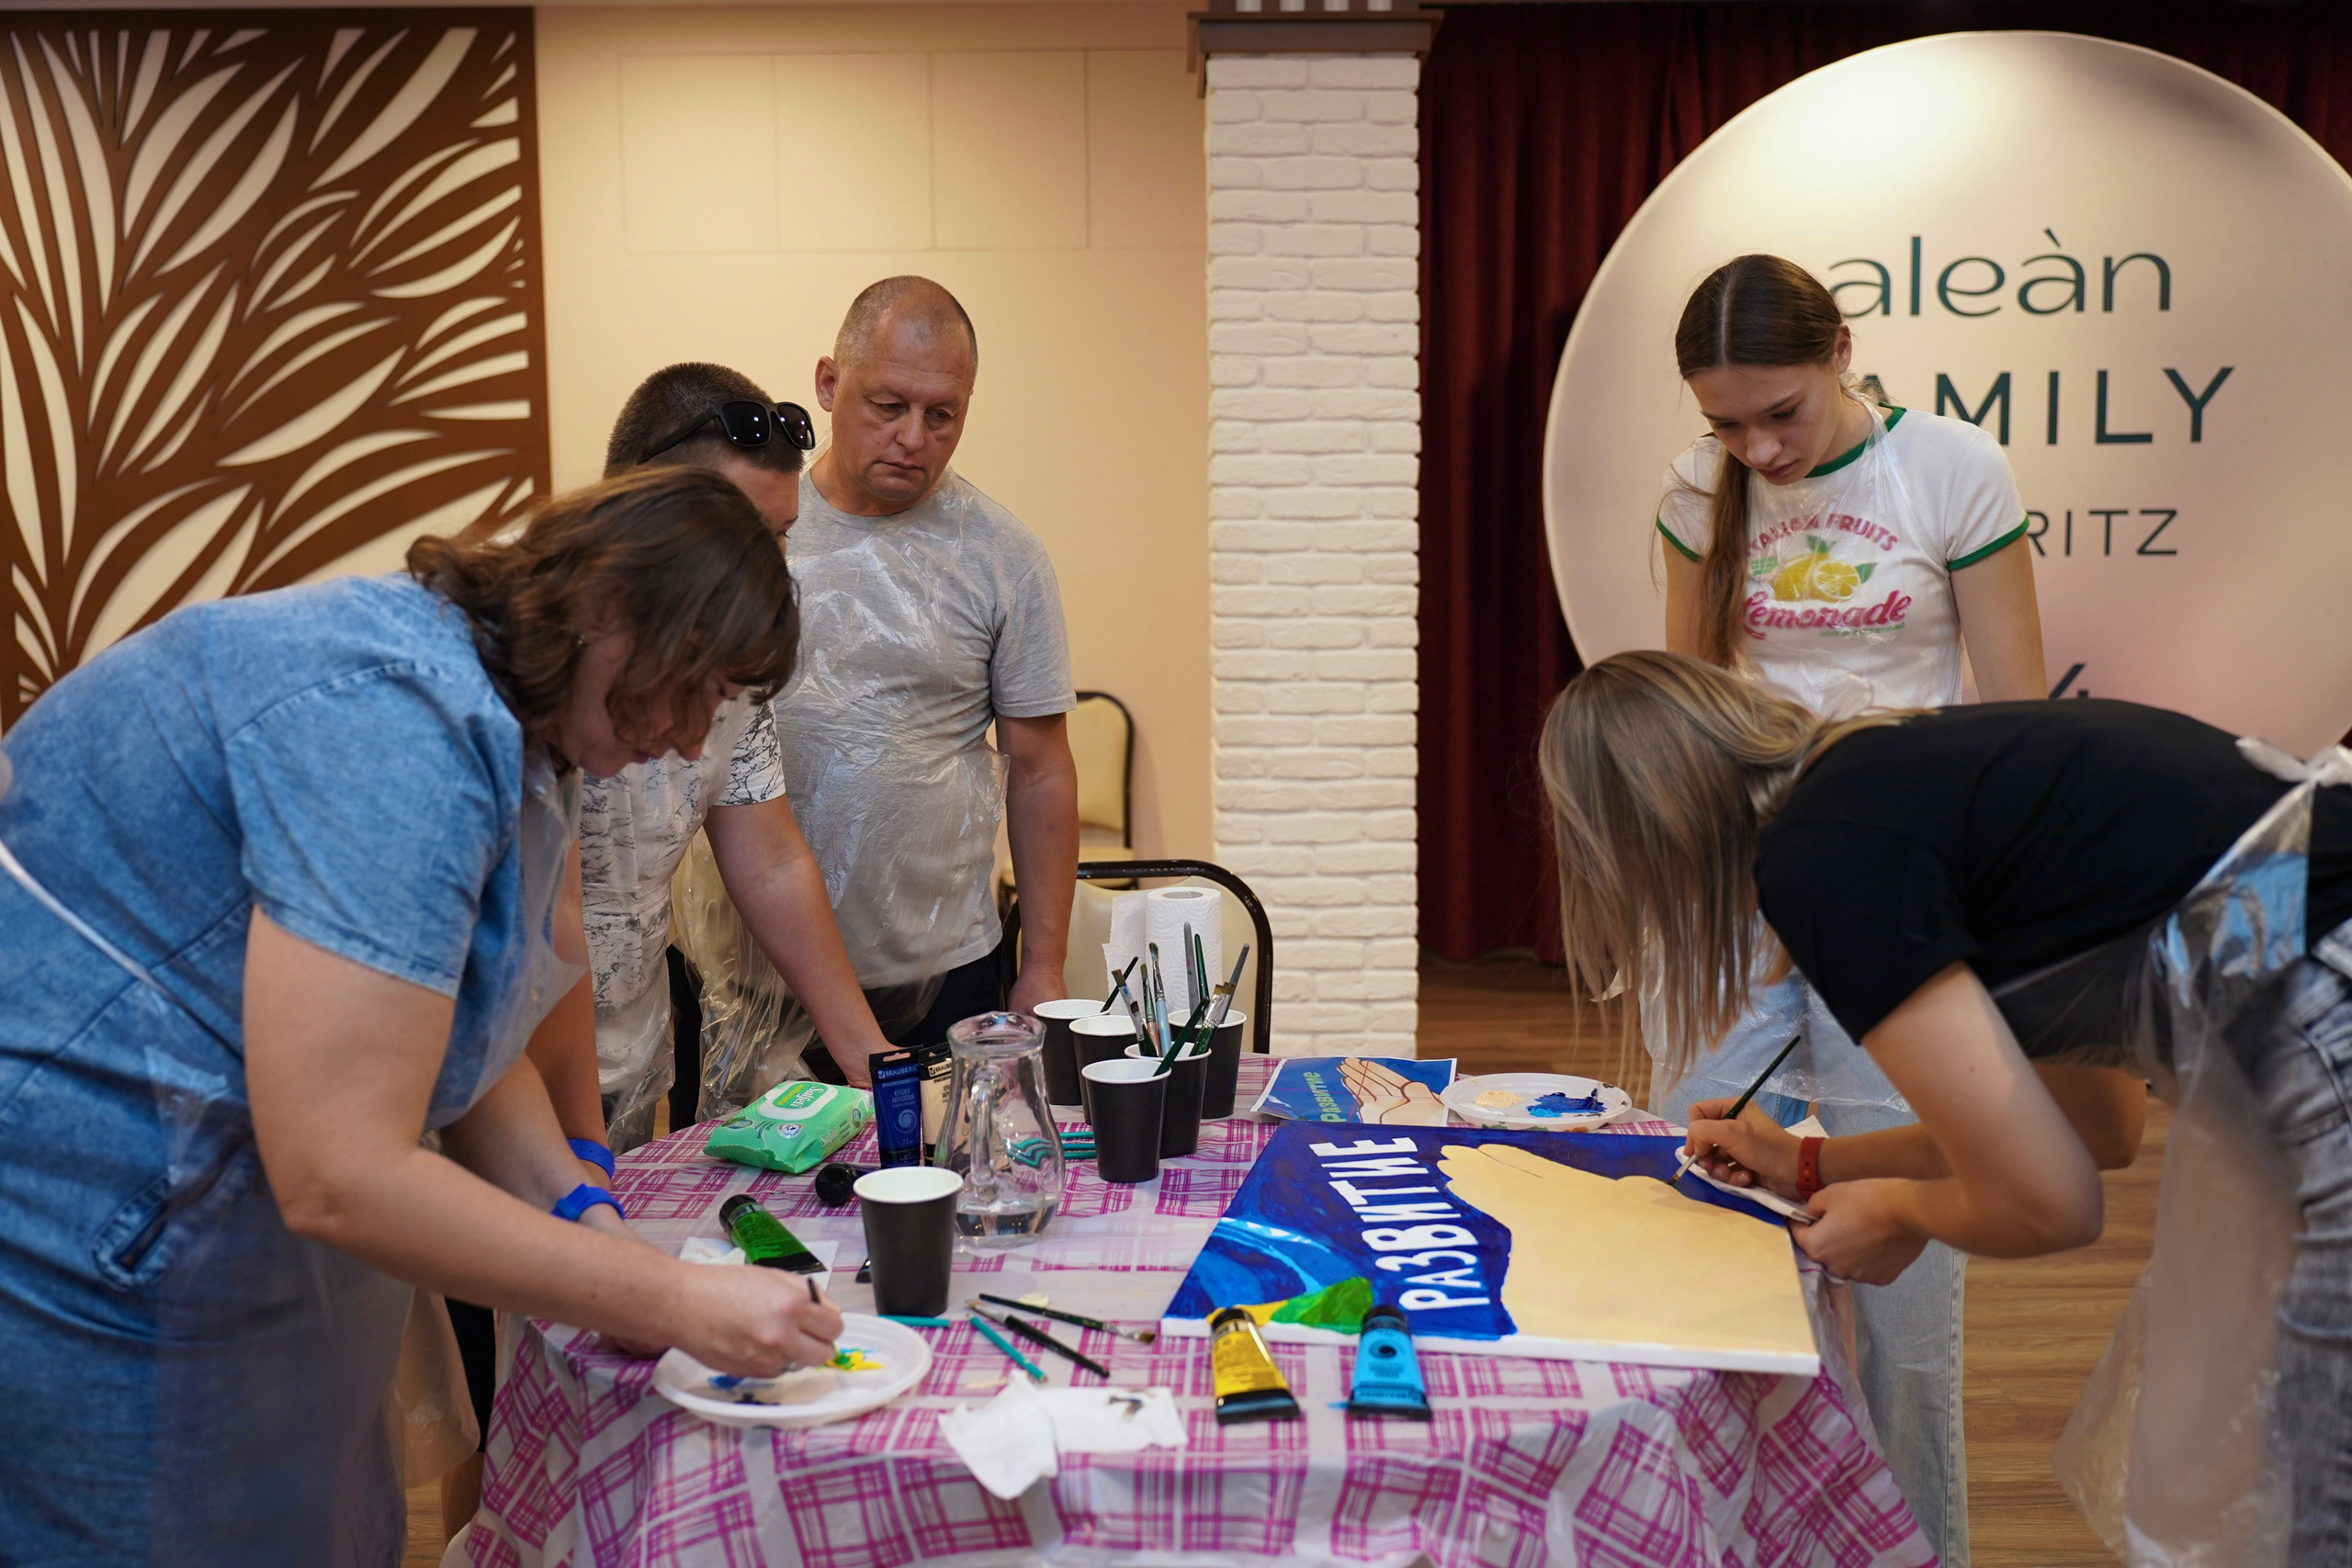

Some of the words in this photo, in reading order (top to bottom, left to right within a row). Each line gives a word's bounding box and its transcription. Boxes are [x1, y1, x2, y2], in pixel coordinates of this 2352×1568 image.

[1827, 227, 2171, 319] aleàn
[1826, 513, 1899, 551] FRUITS
[885, 1066, 918, 1077] BRAUBERG
[1309, 1137, 1490, 1310] РАЗВИТИЕ
